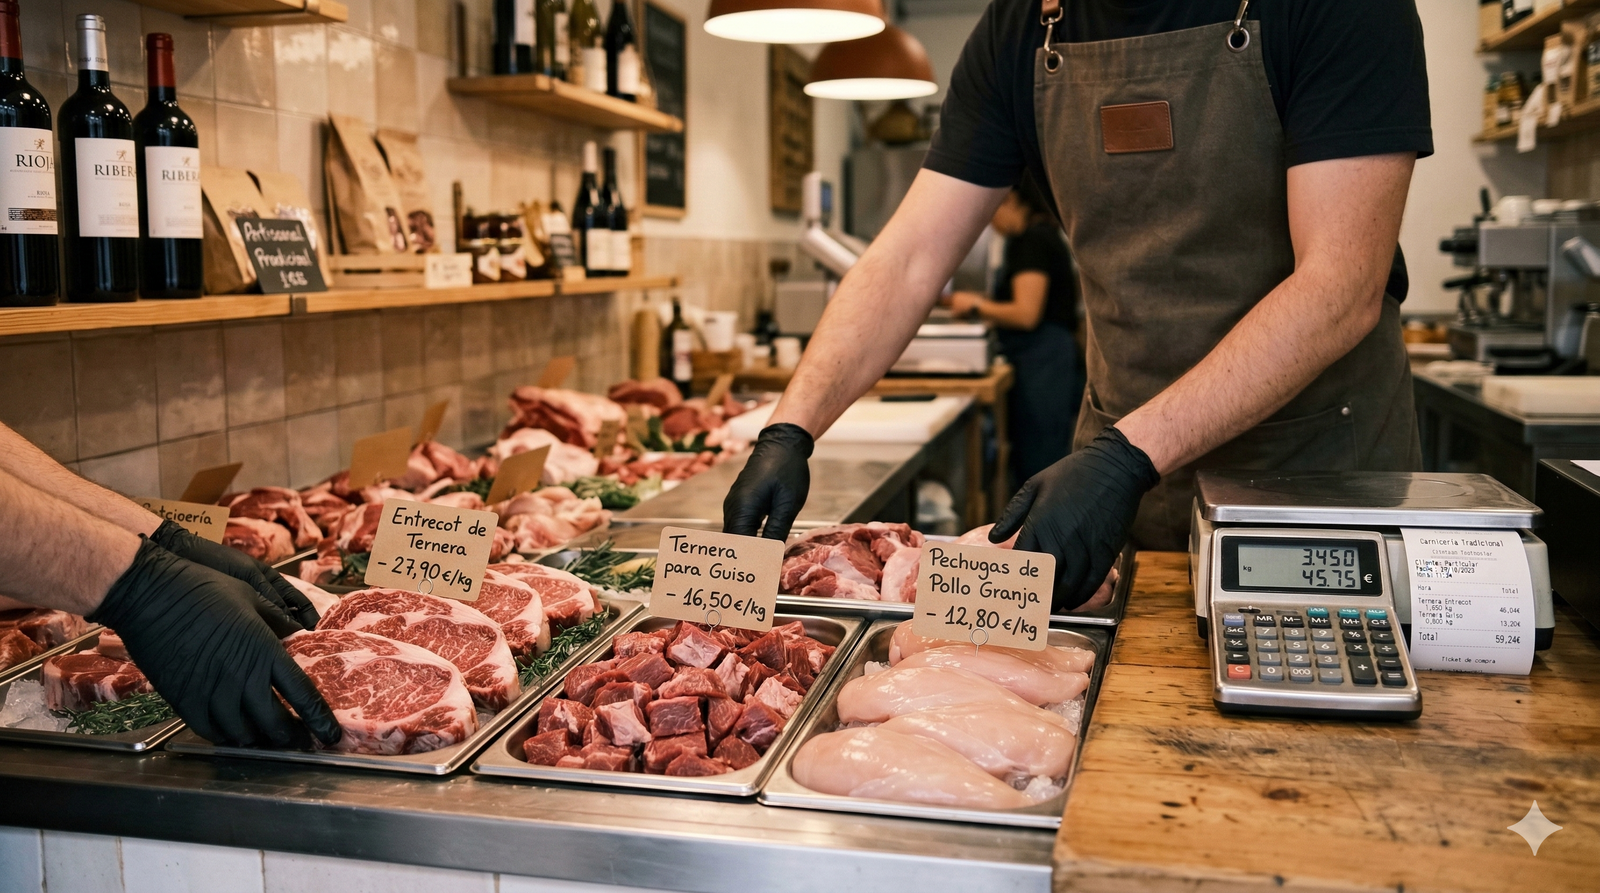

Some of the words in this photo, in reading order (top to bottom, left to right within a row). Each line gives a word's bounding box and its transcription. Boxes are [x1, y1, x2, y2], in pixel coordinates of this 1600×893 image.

[142, 503, 212, 525] tcioería
[392, 507, 462, 531] Entrecot
[468, 520, 486, 536] de
[407, 533, 467, 556] Ternera
[669, 535, 737, 559] Ternera
[929, 548, 1010, 580] Pechugas
[1019, 560, 1039, 577] de
[1302, 548, 1355, 567] 3.450
[664, 563, 701, 578] para
[709, 563, 755, 583] Guiso
[1302, 569, 1356, 588] 45.75
[1363, 573, 1373, 583] €
[929, 573, 970, 595] Pollo
[980, 582, 1040, 609] Granja
[1419, 632, 1438, 640] Total
[1496, 635, 1520, 644] 59,24€
